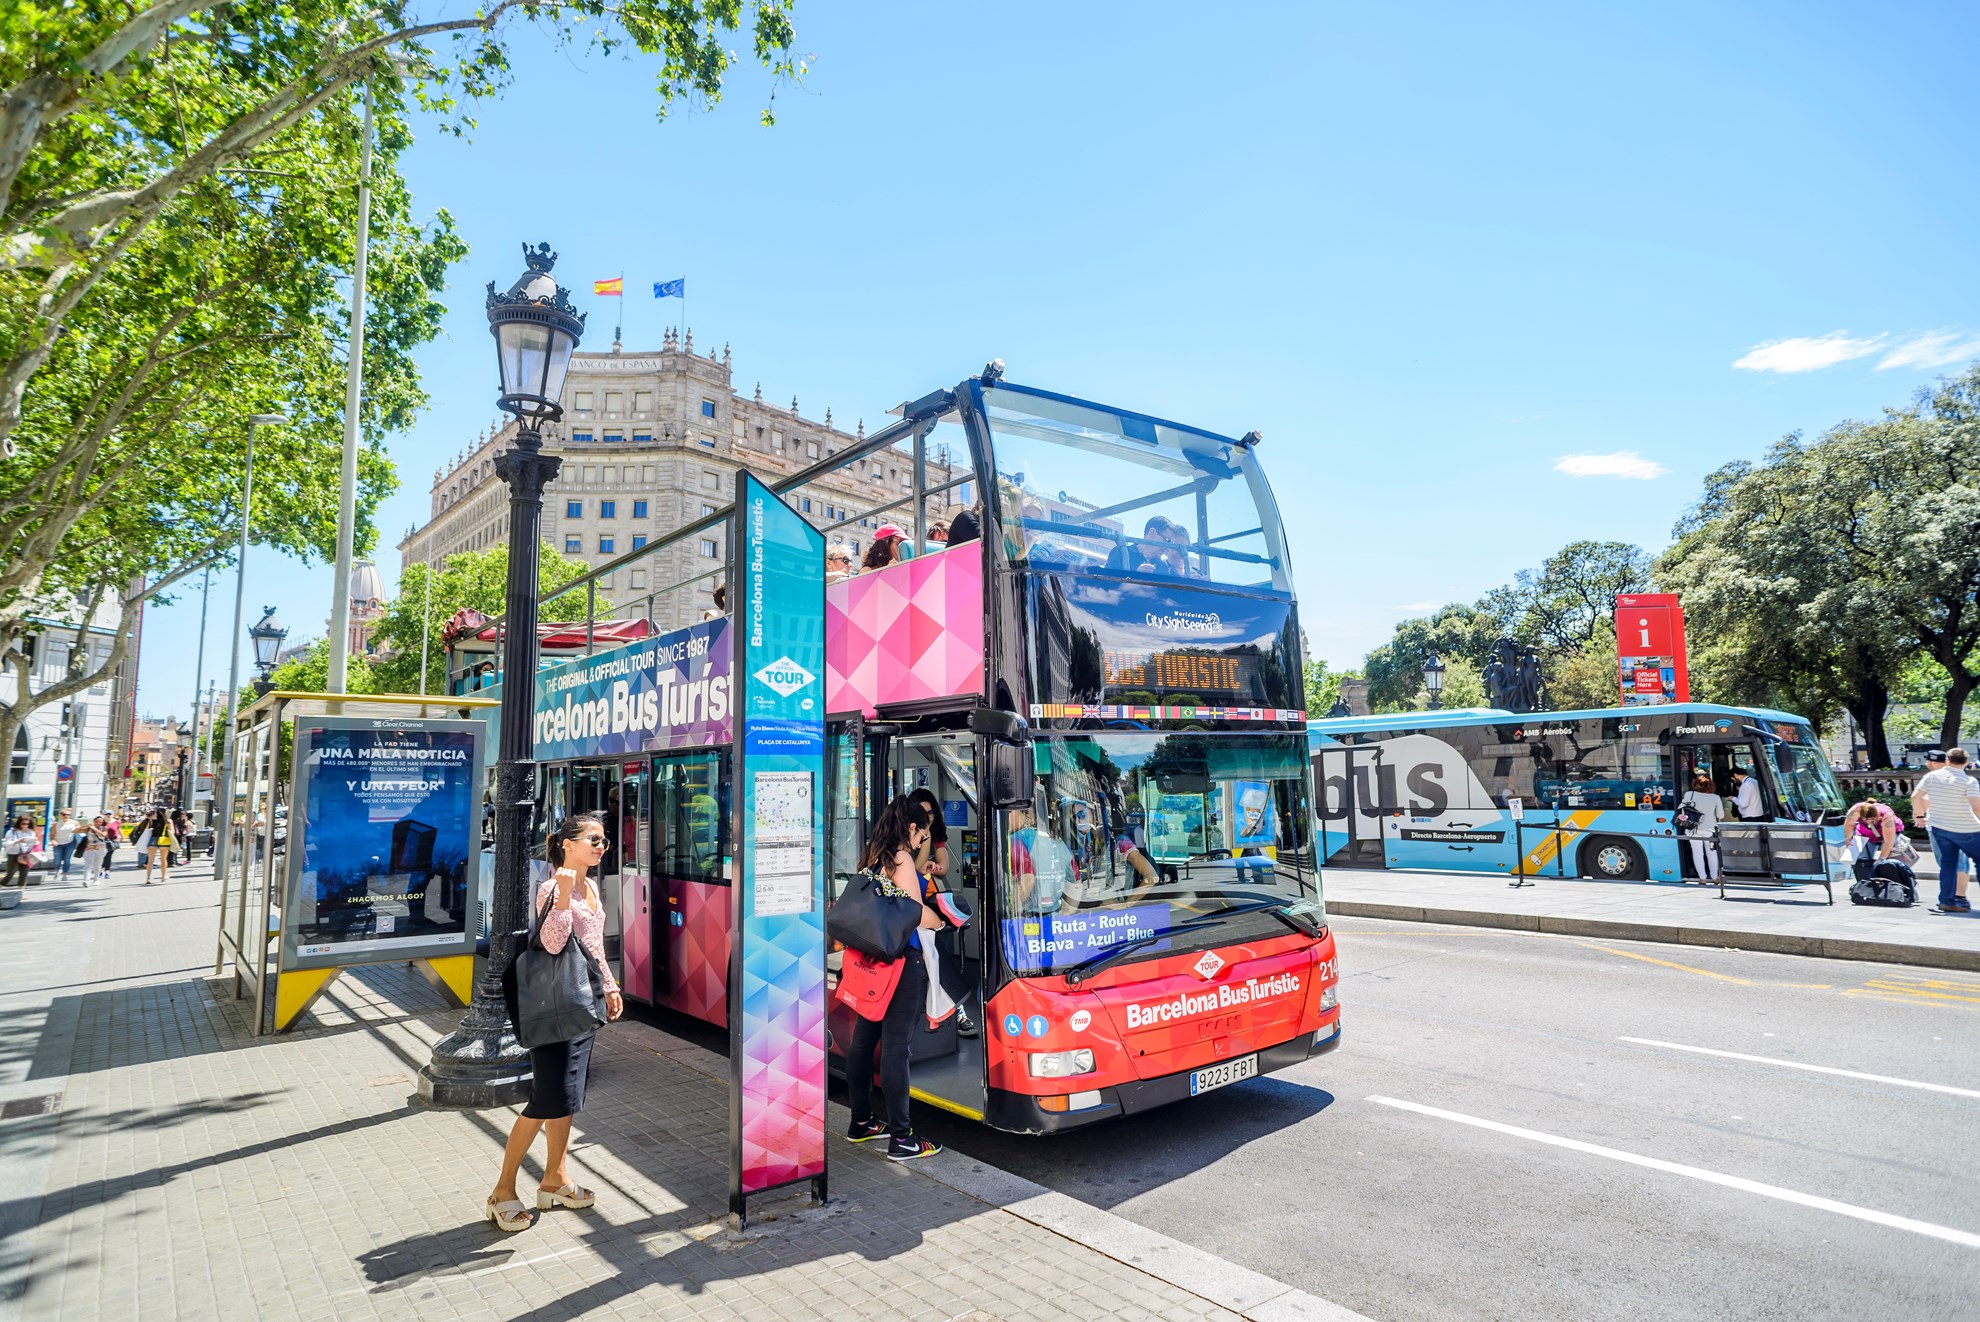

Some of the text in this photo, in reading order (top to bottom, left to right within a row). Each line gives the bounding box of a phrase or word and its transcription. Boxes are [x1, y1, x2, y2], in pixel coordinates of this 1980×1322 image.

[570, 360, 606, 369] BANCO
[622, 360, 658, 369] ESPAÑA
[751, 574, 763, 647] Barcelona
[1174, 611, 1205, 619] Worldwide
[1146, 612, 1213, 635] City Sightseeing
[545, 679, 557, 694] THE
[557, 670, 589, 690] ORIGINAL
[595, 661, 630, 681] OFFICIAL
[631, 650, 655, 671] TOUR
[657, 641, 685, 665] SINCE
[686, 635, 710, 658] 1987
[1103, 651, 1240, 689] BUS TURISTIC
[765, 671, 804, 685] TOUR
[533, 661, 734, 745] rcelona BusTuríst
[382, 720, 398, 728] Clear
[1676, 725, 1716, 734] Free Wifi
[320, 748, 466, 760] UNA MALA NOTICIA
[346, 780, 439, 791] Y UNA PEOR
[1411, 831, 1497, 841] Directo Barcelona-Aeropuerto
[347, 892, 424, 904] ¿HACEMOS ALGO?
[1052, 920, 1087, 935] Ruta
[1099, 914, 1137, 929] Route
[1028, 937, 1074, 953] Blava
[1087, 931, 1116, 947] Azul
[1127, 928, 1155, 942] Blue
[1200, 960, 1219, 971] TOUR
[1126, 992, 1219, 1029] Barcelona
[1074, 1017, 1089, 1025] TMB
[1199, 1066, 1229, 1090] 9223
[1233, 1057, 1255, 1080] FBT
